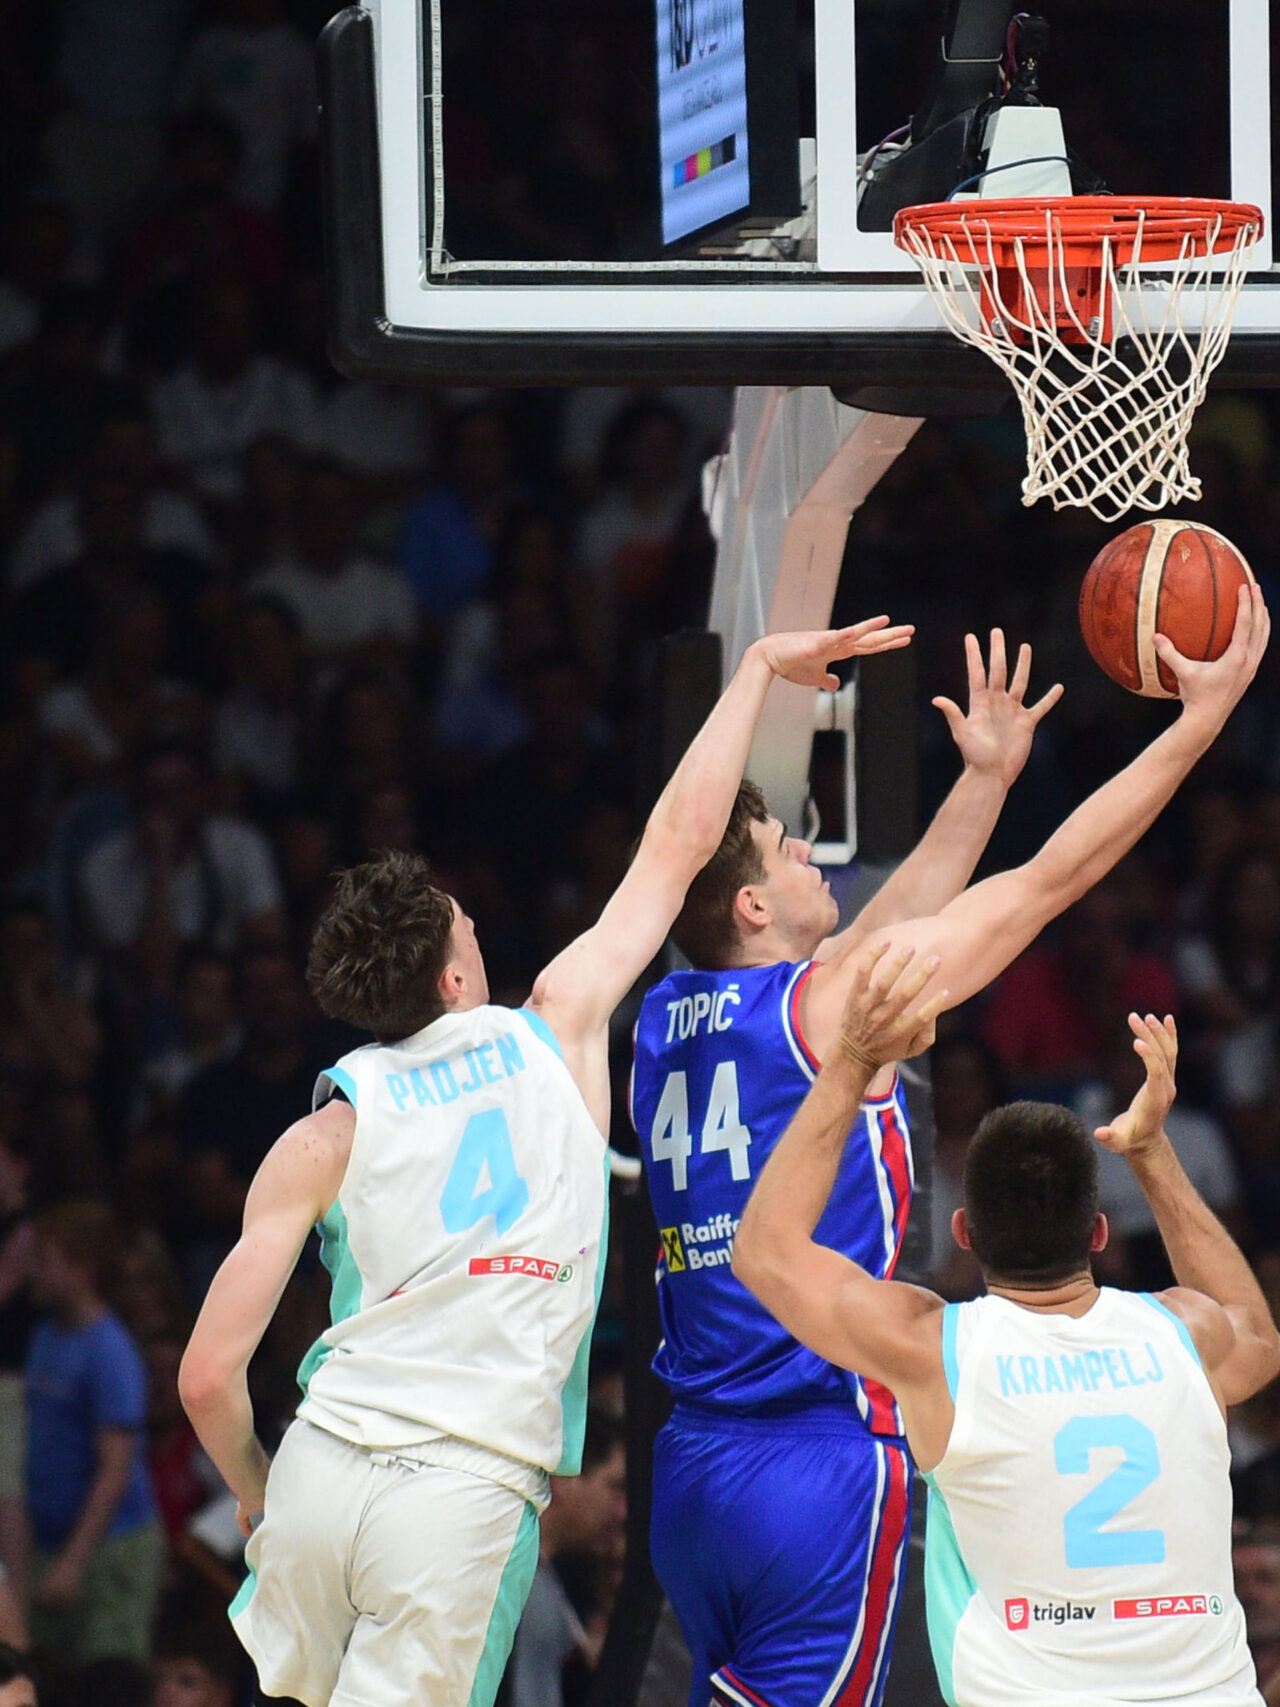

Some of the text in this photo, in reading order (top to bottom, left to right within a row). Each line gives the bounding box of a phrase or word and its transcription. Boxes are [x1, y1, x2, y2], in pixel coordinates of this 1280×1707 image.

[385, 1032, 526, 1112] PADJEN
[651, 1061, 751, 1192] 44
[439, 1107, 530, 1238] 4
[489, 1258, 557, 1278] SPAR
[996, 1342, 1164, 1397] KRAMPELJ
[1053, 1413, 1166, 1569] 2
[1033, 1598, 1206, 1625] triglav SPAR
